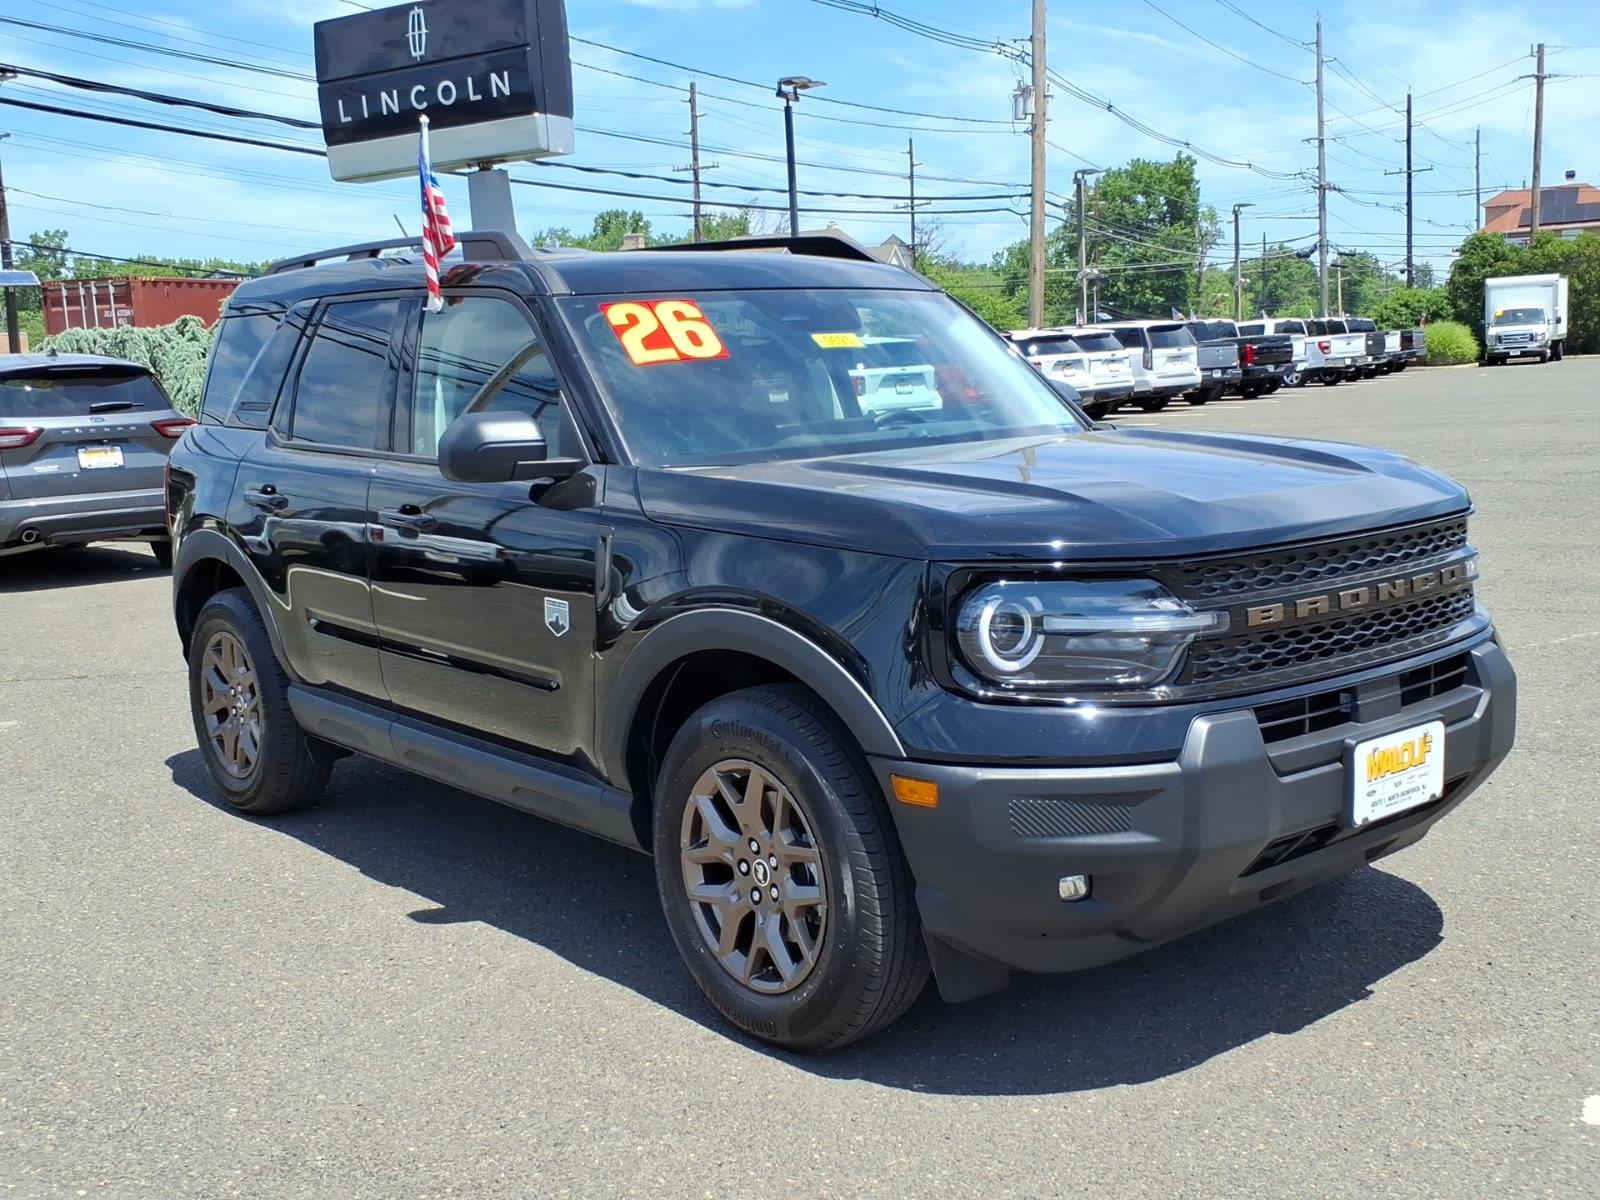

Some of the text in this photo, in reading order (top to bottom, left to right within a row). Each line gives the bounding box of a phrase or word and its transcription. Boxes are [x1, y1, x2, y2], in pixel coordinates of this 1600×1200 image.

[338, 70, 511, 123] LINCOLN
[605, 300, 724, 366] 26
[1247, 564, 1463, 627] BRONCO
[1366, 735, 1433, 783] MALOUF
